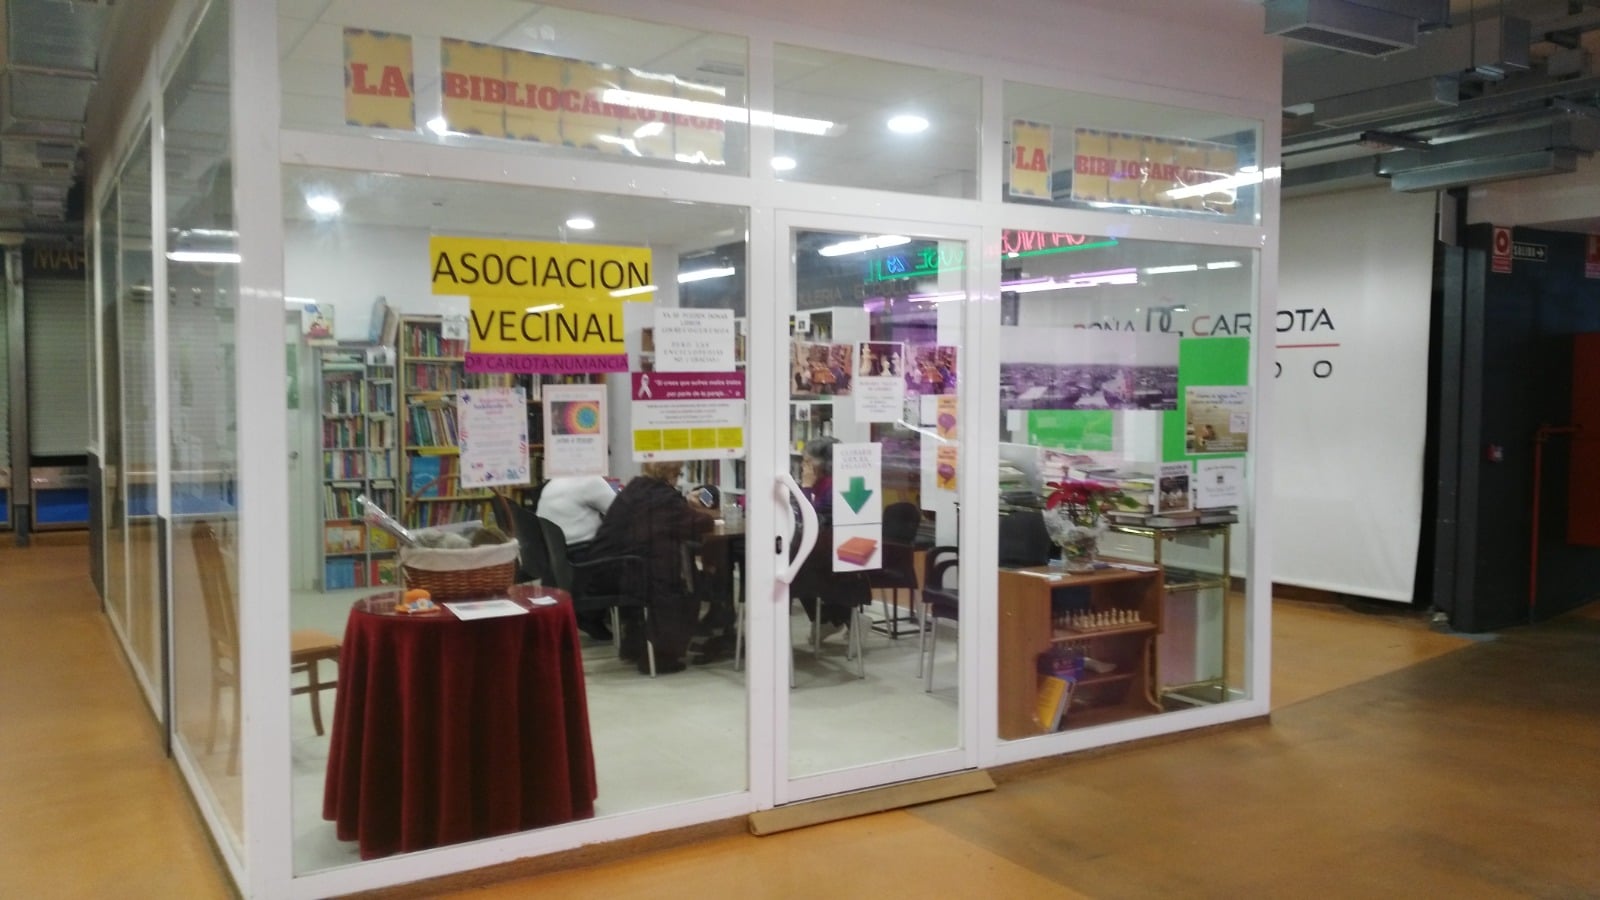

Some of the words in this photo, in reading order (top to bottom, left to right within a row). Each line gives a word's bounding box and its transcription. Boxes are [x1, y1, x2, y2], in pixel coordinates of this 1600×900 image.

[350, 63, 410, 98] LA
[1014, 146, 1048, 173] LA
[432, 252, 650, 290] ASOCIACION
[470, 309, 625, 344] VECINAL
